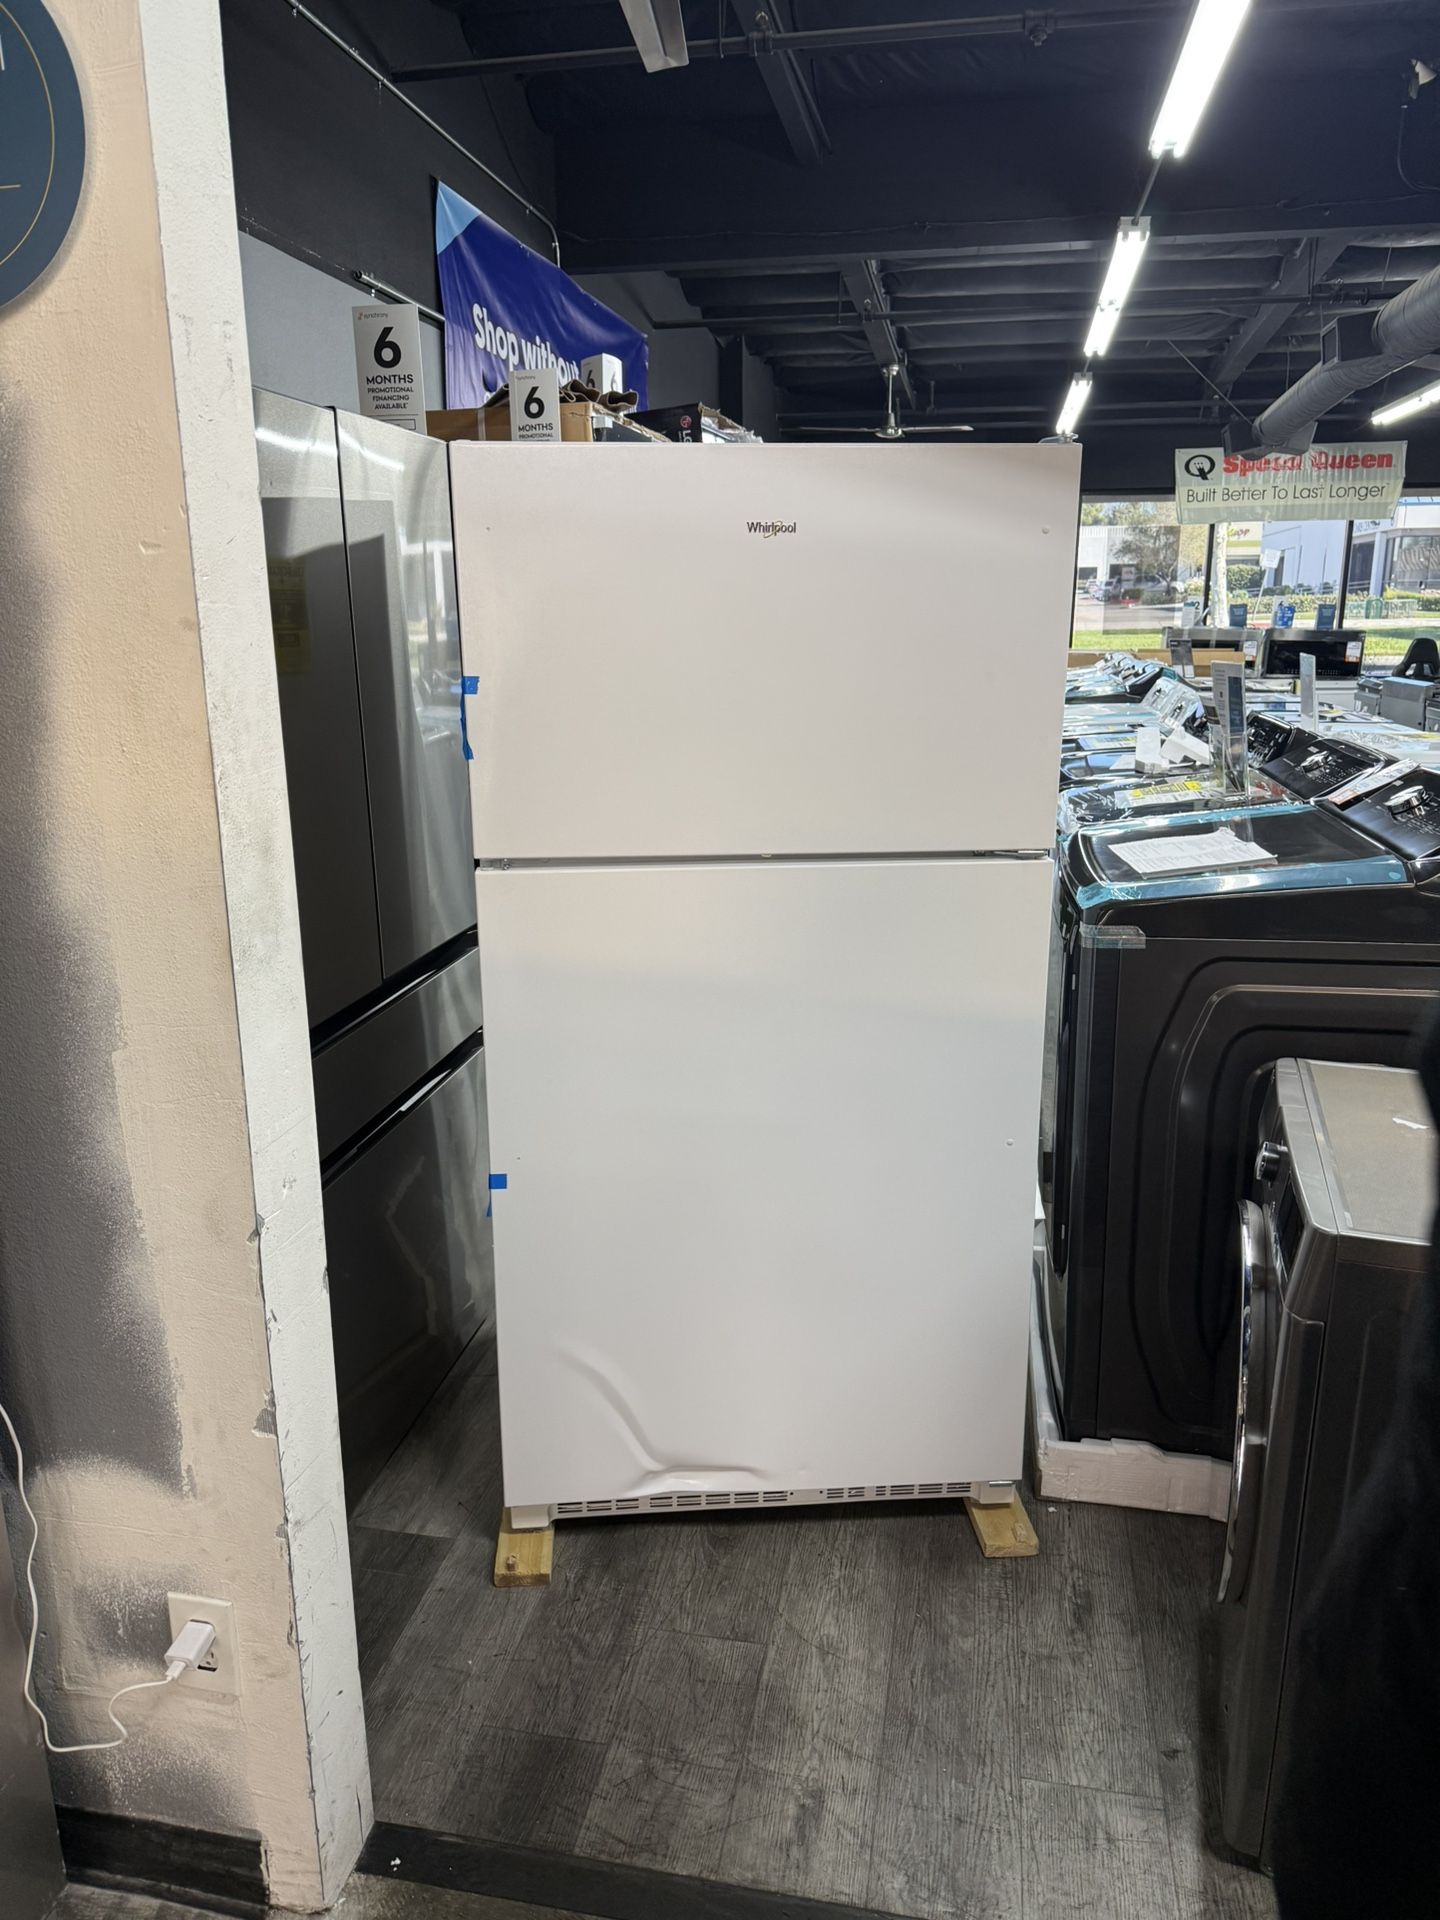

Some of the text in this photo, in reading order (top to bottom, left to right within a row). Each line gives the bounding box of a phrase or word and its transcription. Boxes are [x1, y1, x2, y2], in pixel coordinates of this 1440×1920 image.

[374, 326, 402, 368] 6
[472, 303, 580, 386] Shop without
[366, 374, 414, 385] MONTHS
[367, 386, 414, 394] PROMOTIONAL
[373, 394, 410, 402] FINANCING
[524, 386, 545, 419] 6
[518, 423, 553, 432] MONTHS
[1311, 450, 1393, 471] Queen
[1186, 488, 1217, 503] Built
[1221, 487, 1267, 502] Better
[1271, 485, 1288, 500] To
[1293, 484, 1324, 499] Last
[746, 521, 796, 537] Whirlpool
